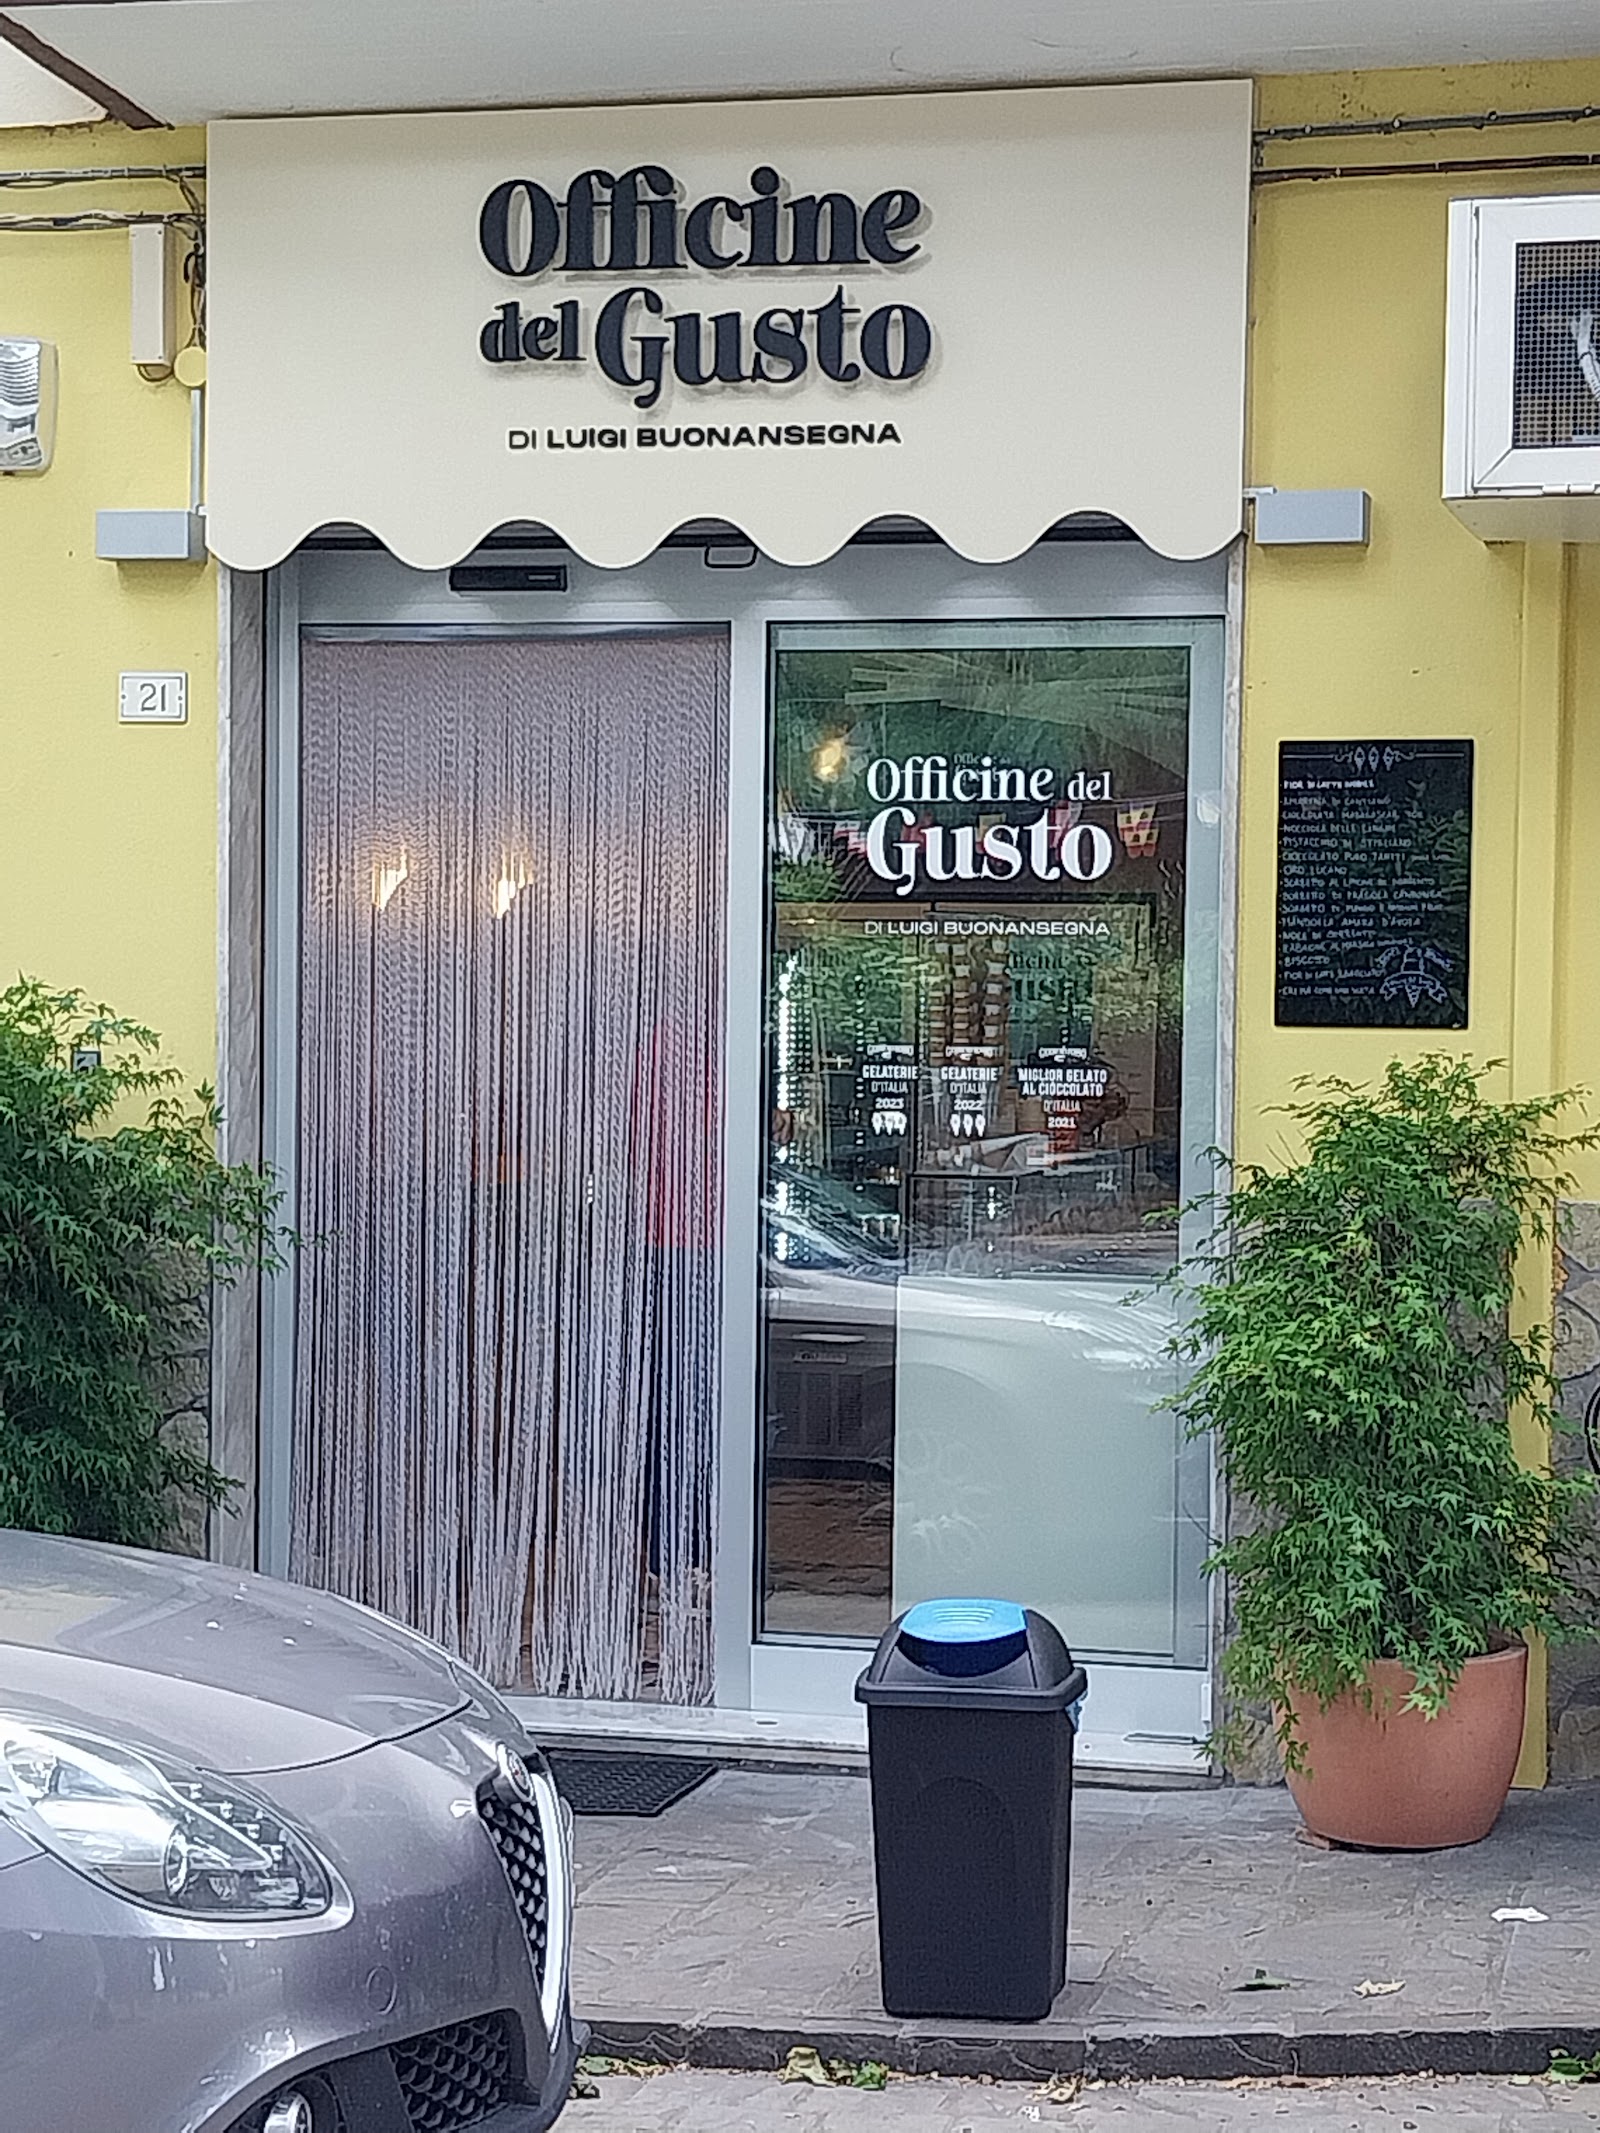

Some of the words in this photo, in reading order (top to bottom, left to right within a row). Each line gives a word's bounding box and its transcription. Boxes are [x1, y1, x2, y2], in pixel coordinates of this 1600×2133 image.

[479, 165, 921, 277] Officine
[479, 300, 587, 363] del
[594, 284, 932, 409] Gusto
[509, 429, 537, 450] DI
[547, 427, 627, 450] LUIGI
[636, 423, 901, 448] BUONANSEGNA
[140, 683, 167, 713] 21
[866, 756, 1054, 803] Officine
[1066, 770, 1113, 801] del
[865, 807, 1113, 896] Gusto
[864, 921, 882, 935] DI
[887, 921, 938, 935] LUIGI
[943, 920, 1111, 936] BUONANSEGNA
[862, 1065, 919, 1080] GELATERIE
[941, 1066, 998, 1081] GELATERIE
[1018, 1068, 1063, 1082] MIGLIOR
[1066, 1069, 1108, 1083] GELATO
[1022, 1082, 1037, 1095] AL
[1038, 1083, 1104, 1097] CIOCCOLATO
[954, 1099, 984, 1111] 2022
[1047, 1116, 1077, 1129] 2021
